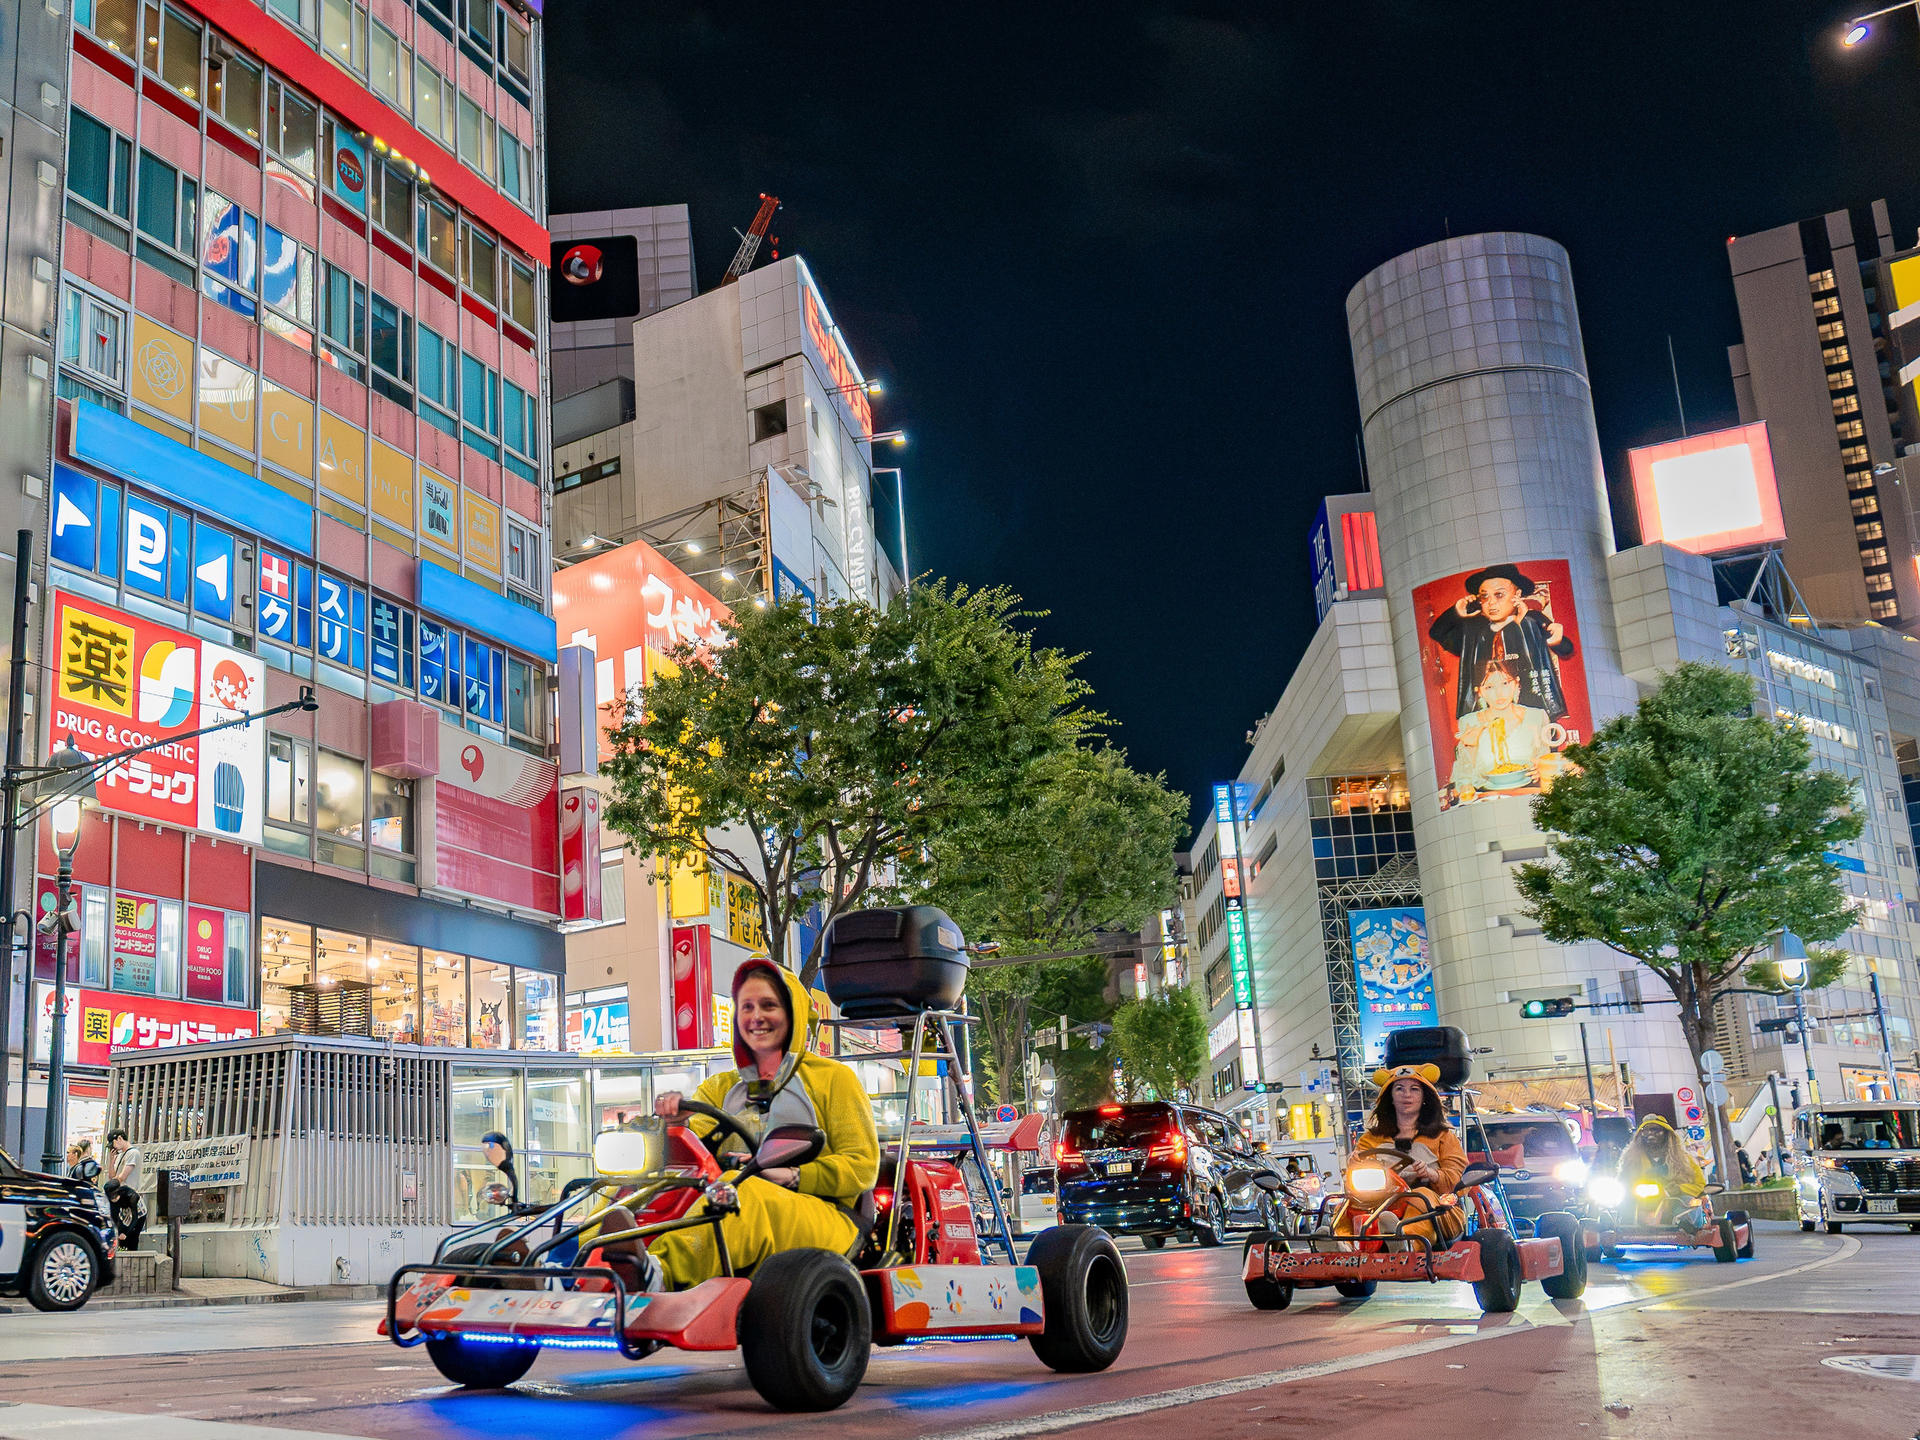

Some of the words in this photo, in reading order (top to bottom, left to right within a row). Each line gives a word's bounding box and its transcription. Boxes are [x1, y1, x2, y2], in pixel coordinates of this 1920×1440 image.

[342, 458, 411, 507] CLINIC
[850, 526, 868, 601] CAMER
[66, 620, 128, 708] 薬
[56, 710, 102, 738] DRUG
[105, 724, 118, 744] &
[119, 730, 196, 765] COSMETIC
[53, 739, 197, 806] ドラッグ
[116, 901, 135, 926] 薬
[196, 945, 212, 955] DRUG
[187, 964, 206, 973] HEALTH
[206, 967, 222, 976] FOOD
[86, 1011, 108, 1040] 薬
[584, 1008, 609, 1043] 24
[110, 1045, 142, 1055] SUND
